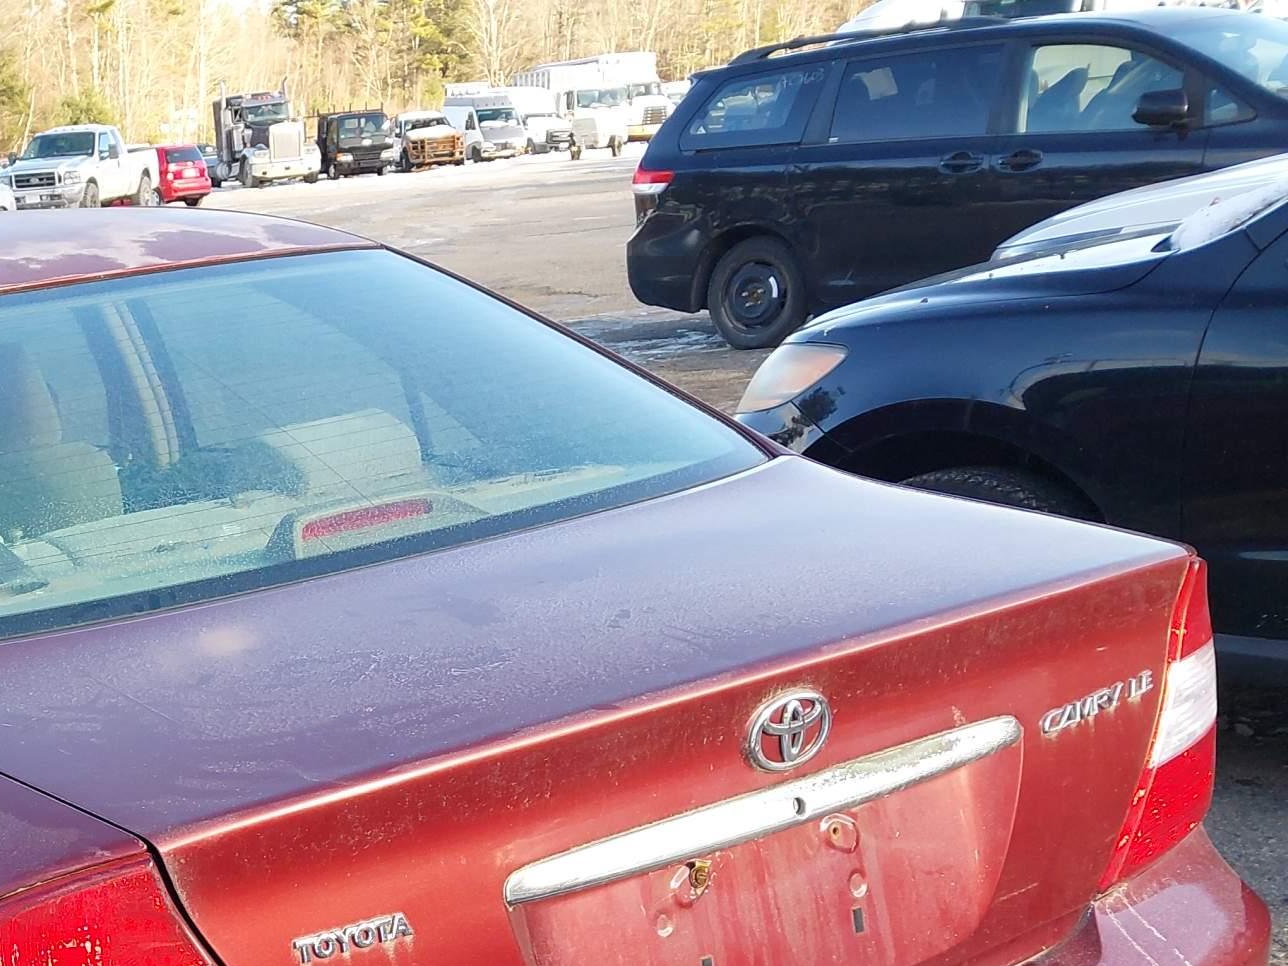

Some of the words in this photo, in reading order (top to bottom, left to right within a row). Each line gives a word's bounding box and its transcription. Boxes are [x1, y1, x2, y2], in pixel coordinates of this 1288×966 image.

[1041, 681, 1124, 733] CAMRY
[1127, 669, 1153, 698] LE
[291, 912, 413, 963] TOYOTA
